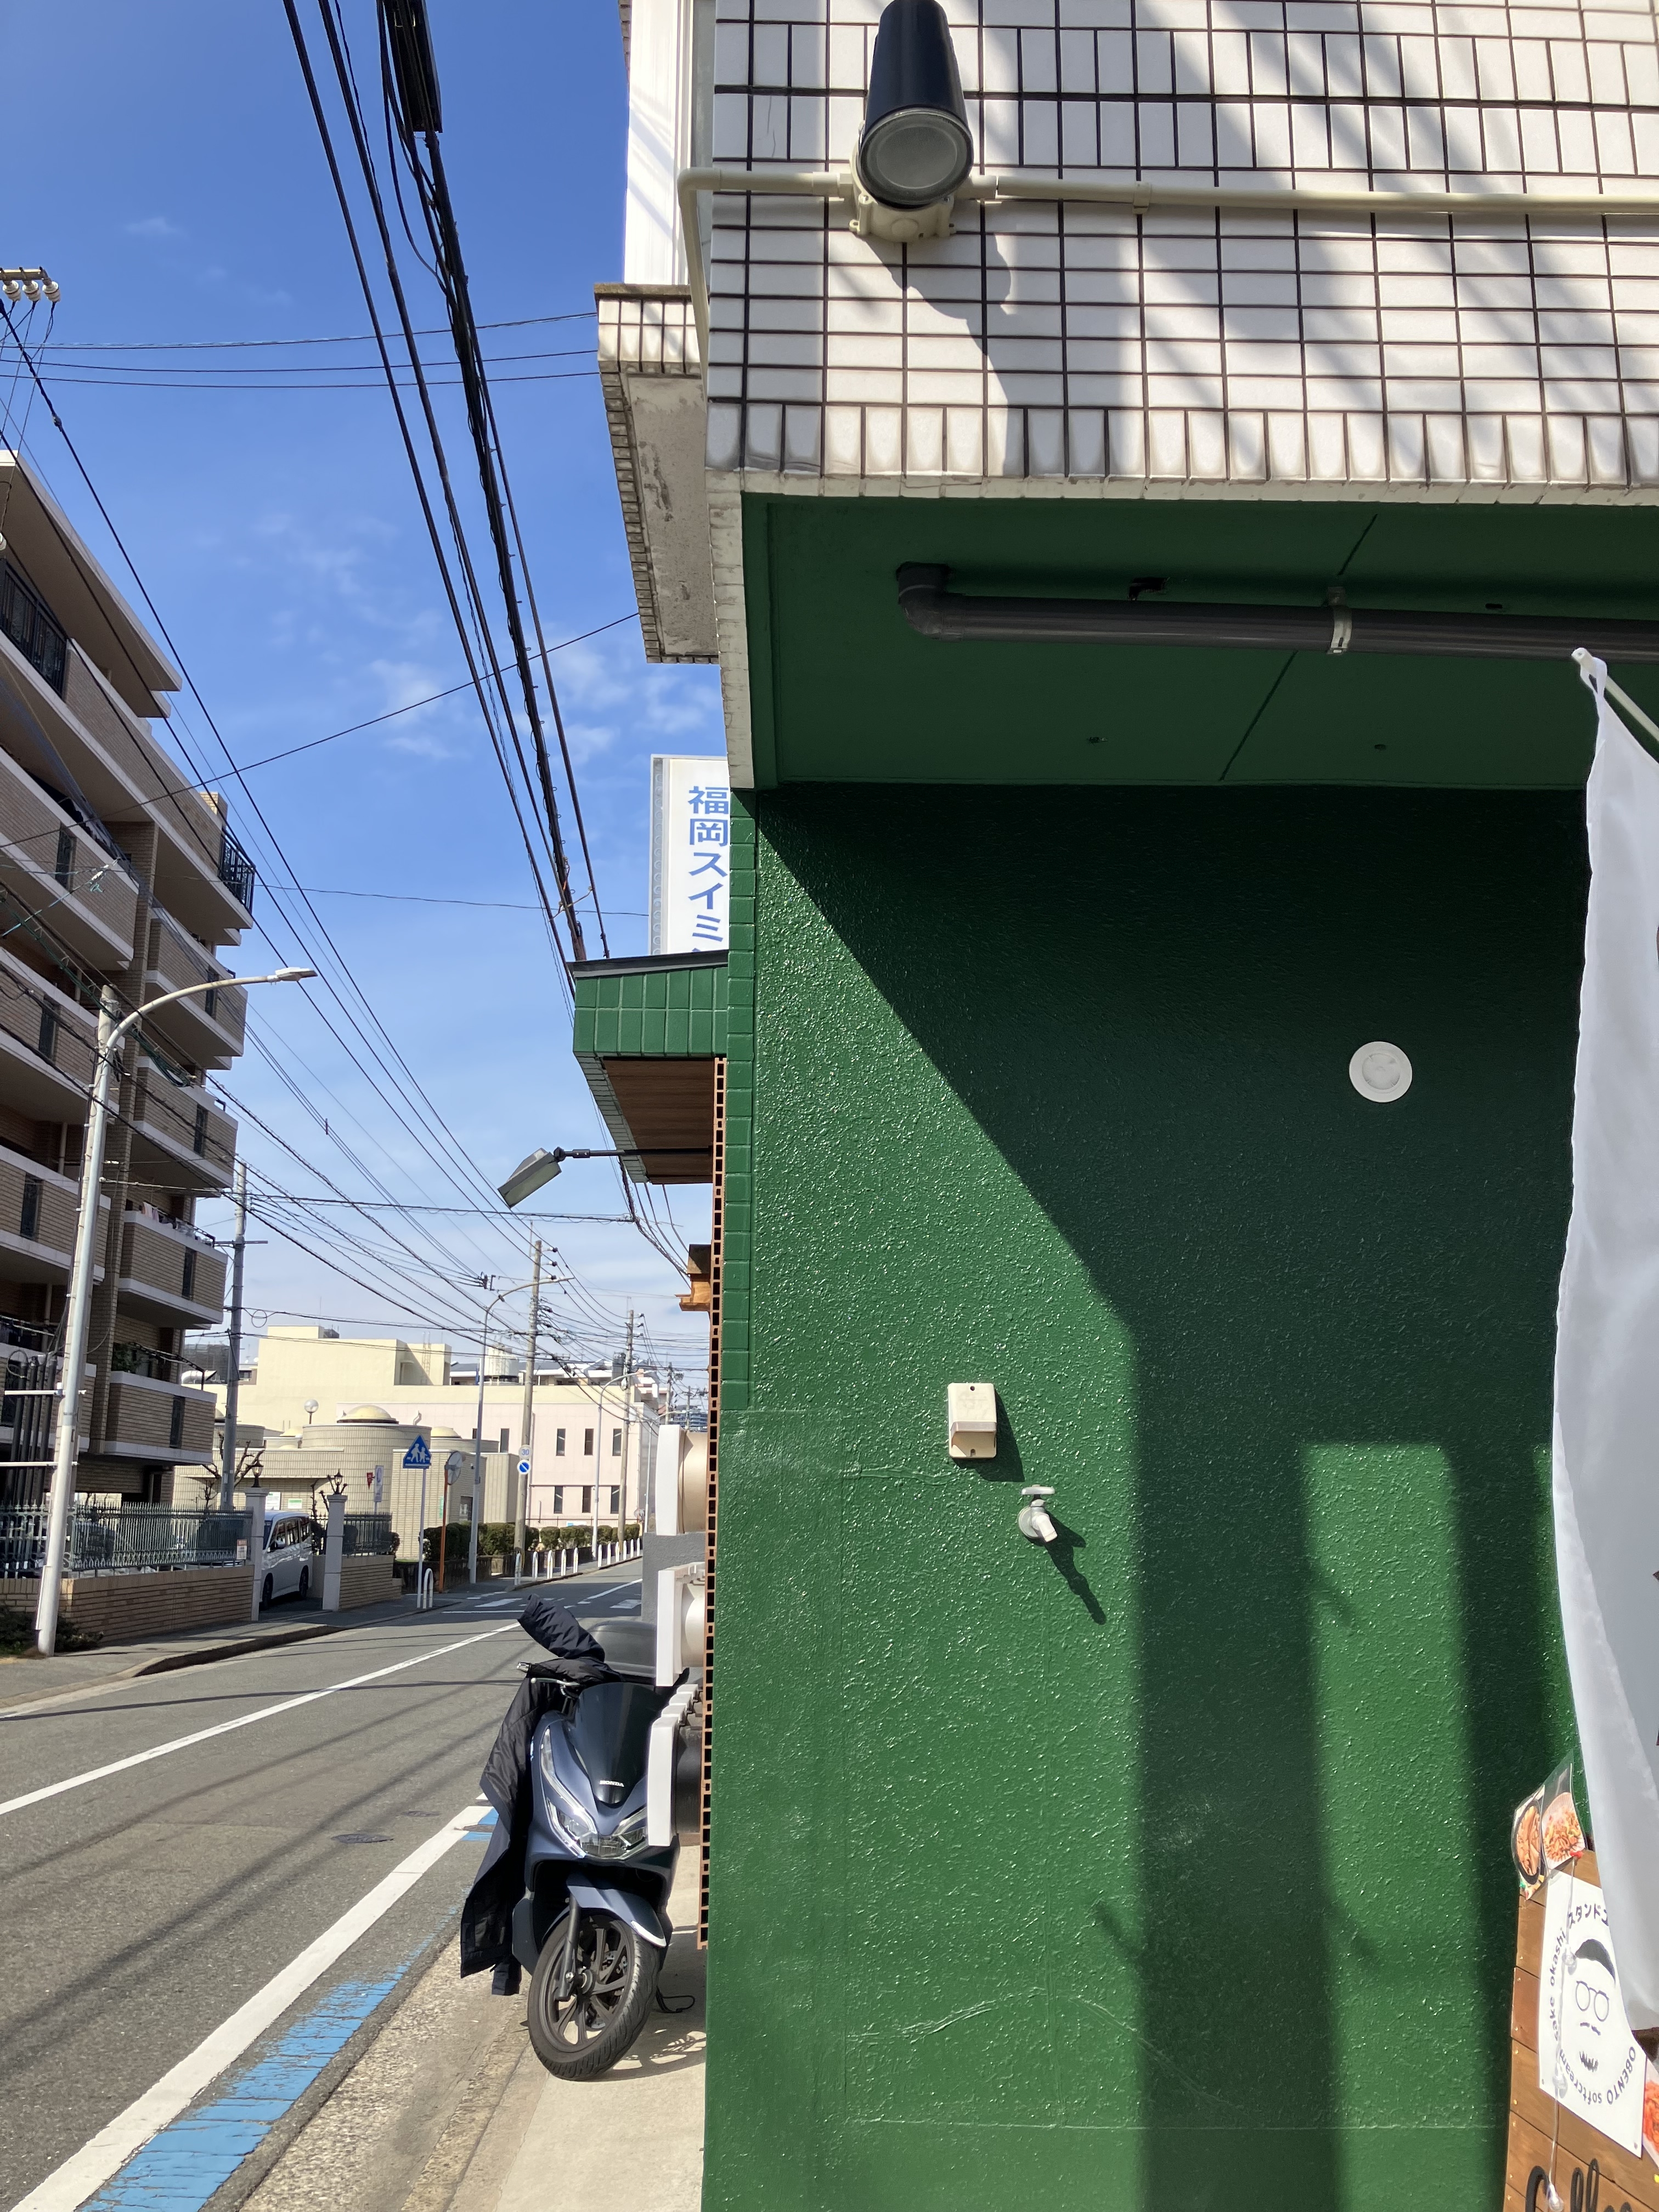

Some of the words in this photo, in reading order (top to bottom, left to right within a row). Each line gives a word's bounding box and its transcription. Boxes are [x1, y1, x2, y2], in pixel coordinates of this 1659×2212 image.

[687, 786, 729, 952] 福岡スイミ
[1549, 1927, 1566, 1987] okashi
[1607, 2046, 1636, 2104] OBENTO
